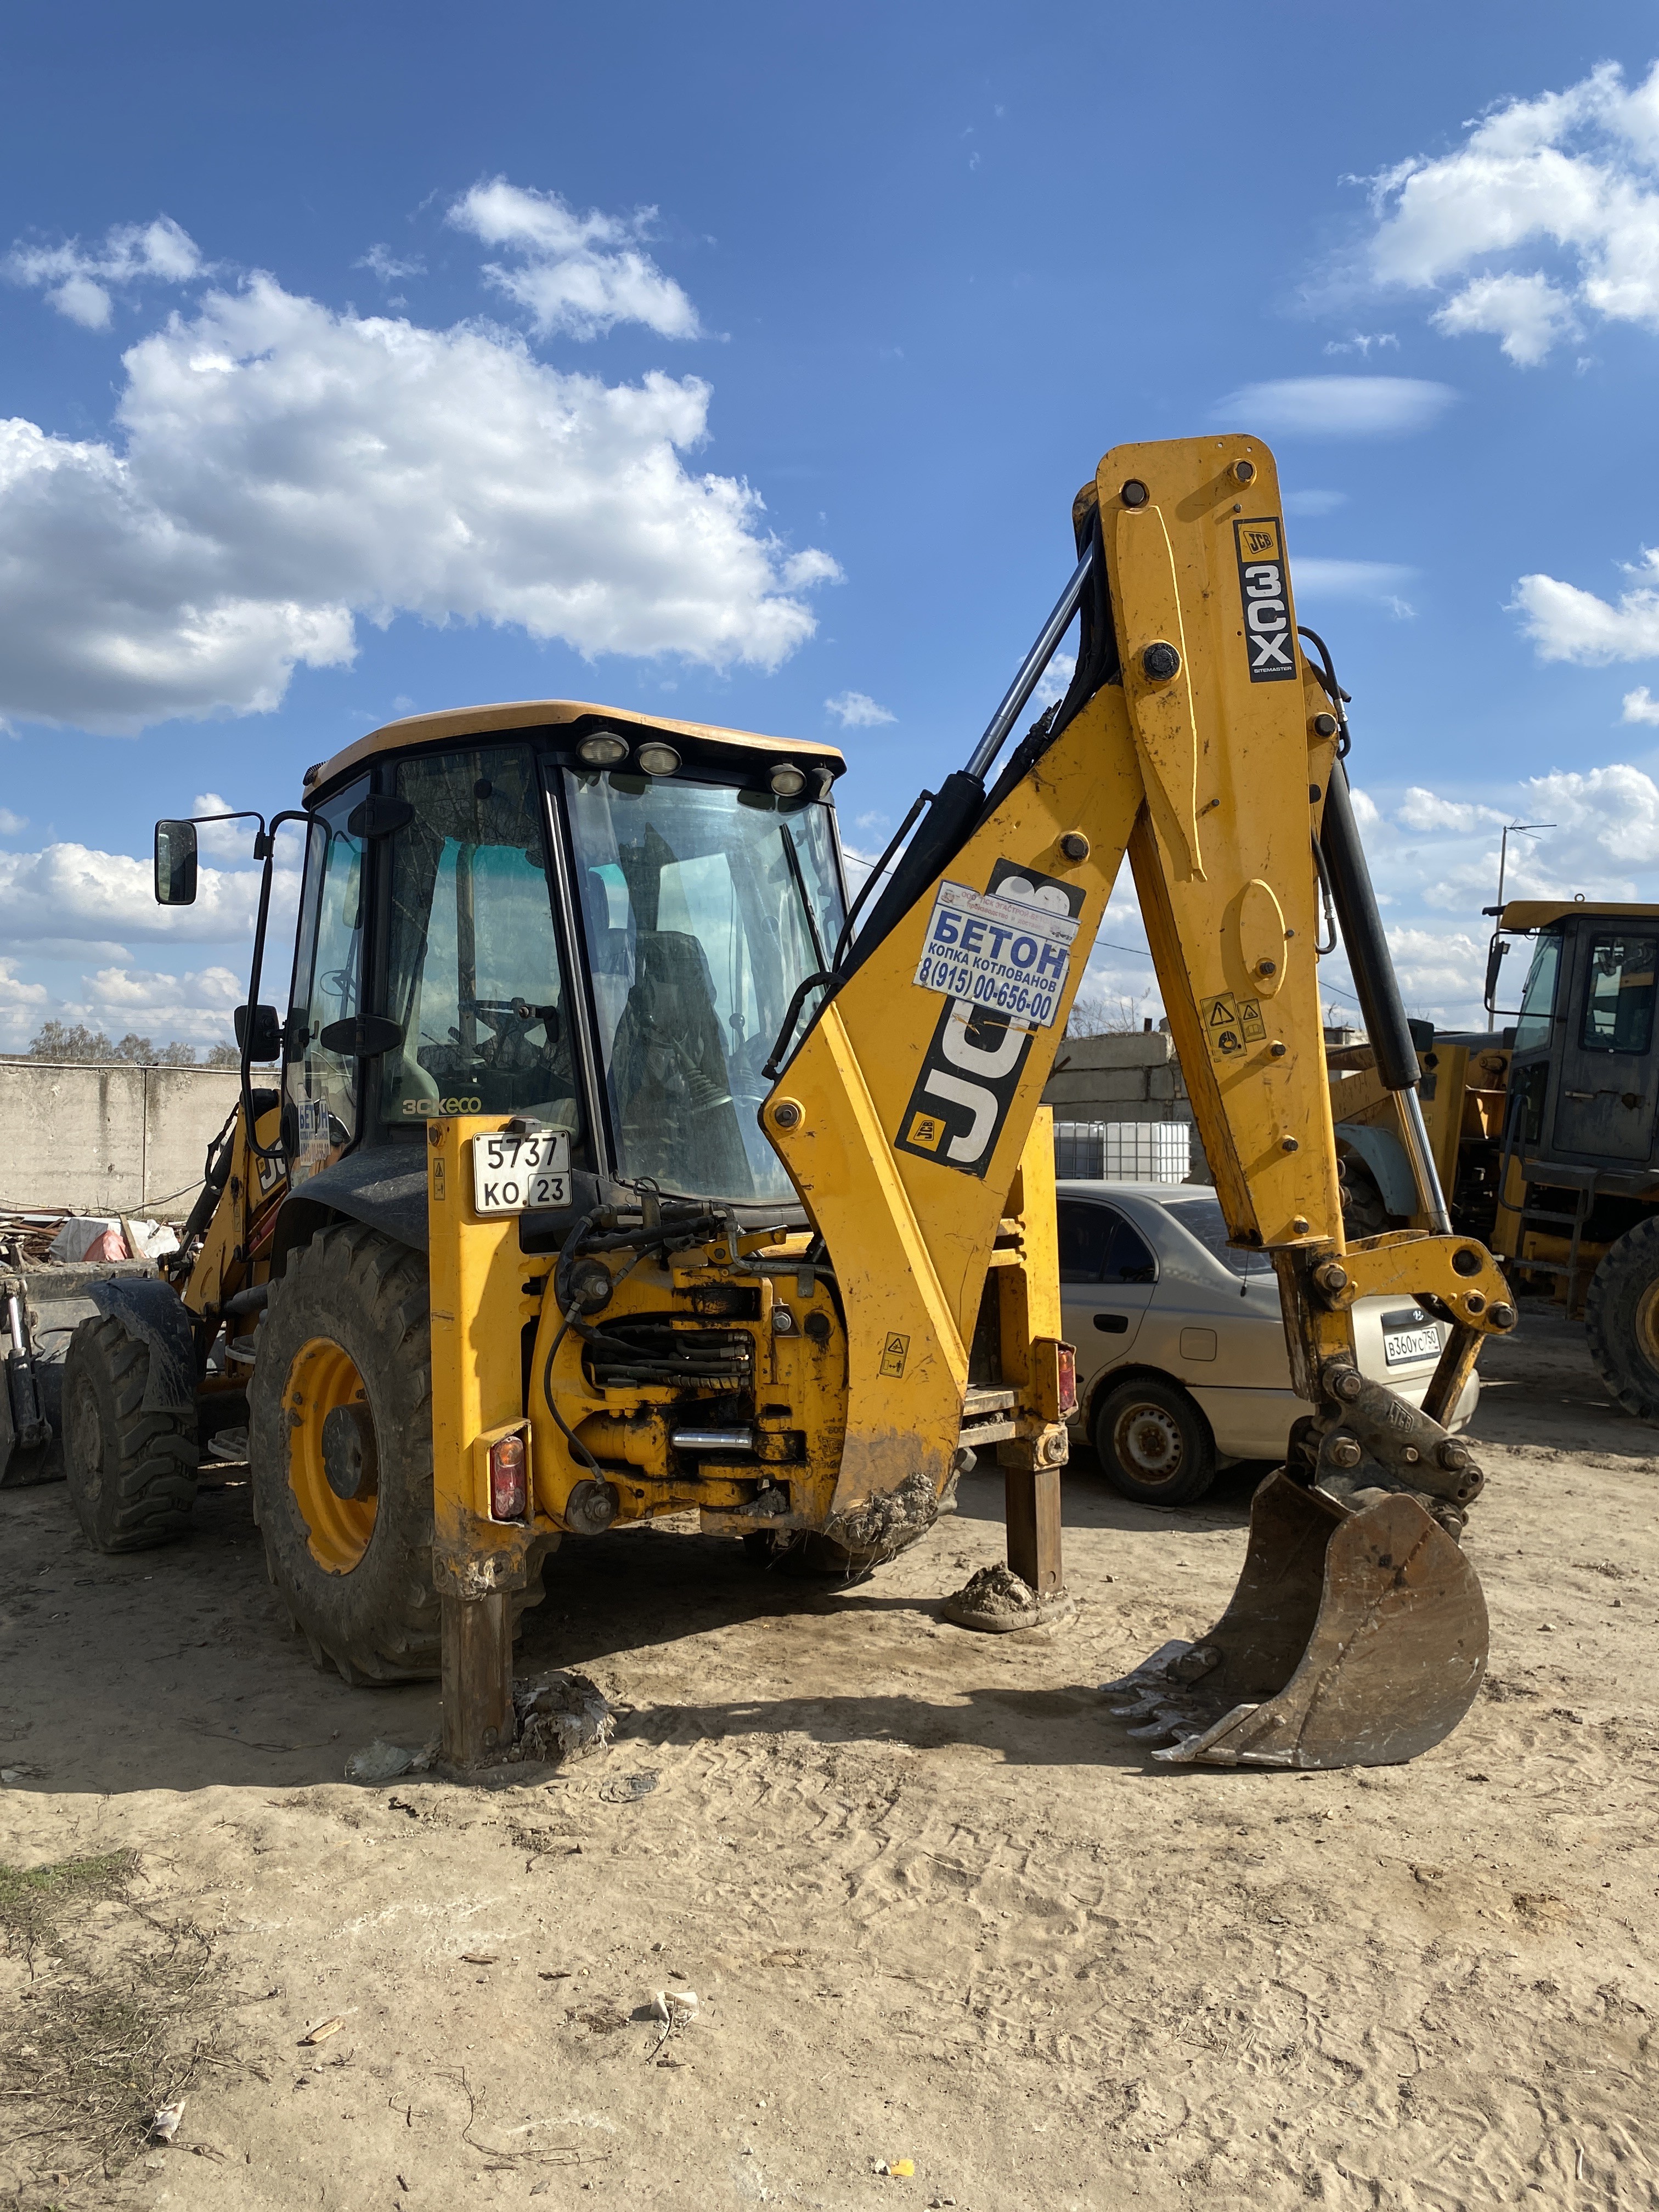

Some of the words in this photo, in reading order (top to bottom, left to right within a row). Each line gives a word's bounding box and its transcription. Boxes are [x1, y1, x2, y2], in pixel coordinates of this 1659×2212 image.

[1248, 533, 1272, 551] JCB
[1245, 565, 1293, 666] 3CX
[933, 910, 1068, 980] БЕТОН
[928, 942, 969, 965] КОПКА
[973, 957, 1057, 992] КОТЛОВАНОВ
[973, 975, 1052, 1020] 00-656-00
[300, 1104, 328, 1129] БЕТН
[917, 1122, 933, 1139] JCB
[488, 1137, 557, 1169] 5737
[484, 1182, 520, 1206] КО
[537, 1178, 564, 1202] 23
[1388, 1335, 1424, 1356] В360УС
[1423, 1330, 1436, 1345] 750
